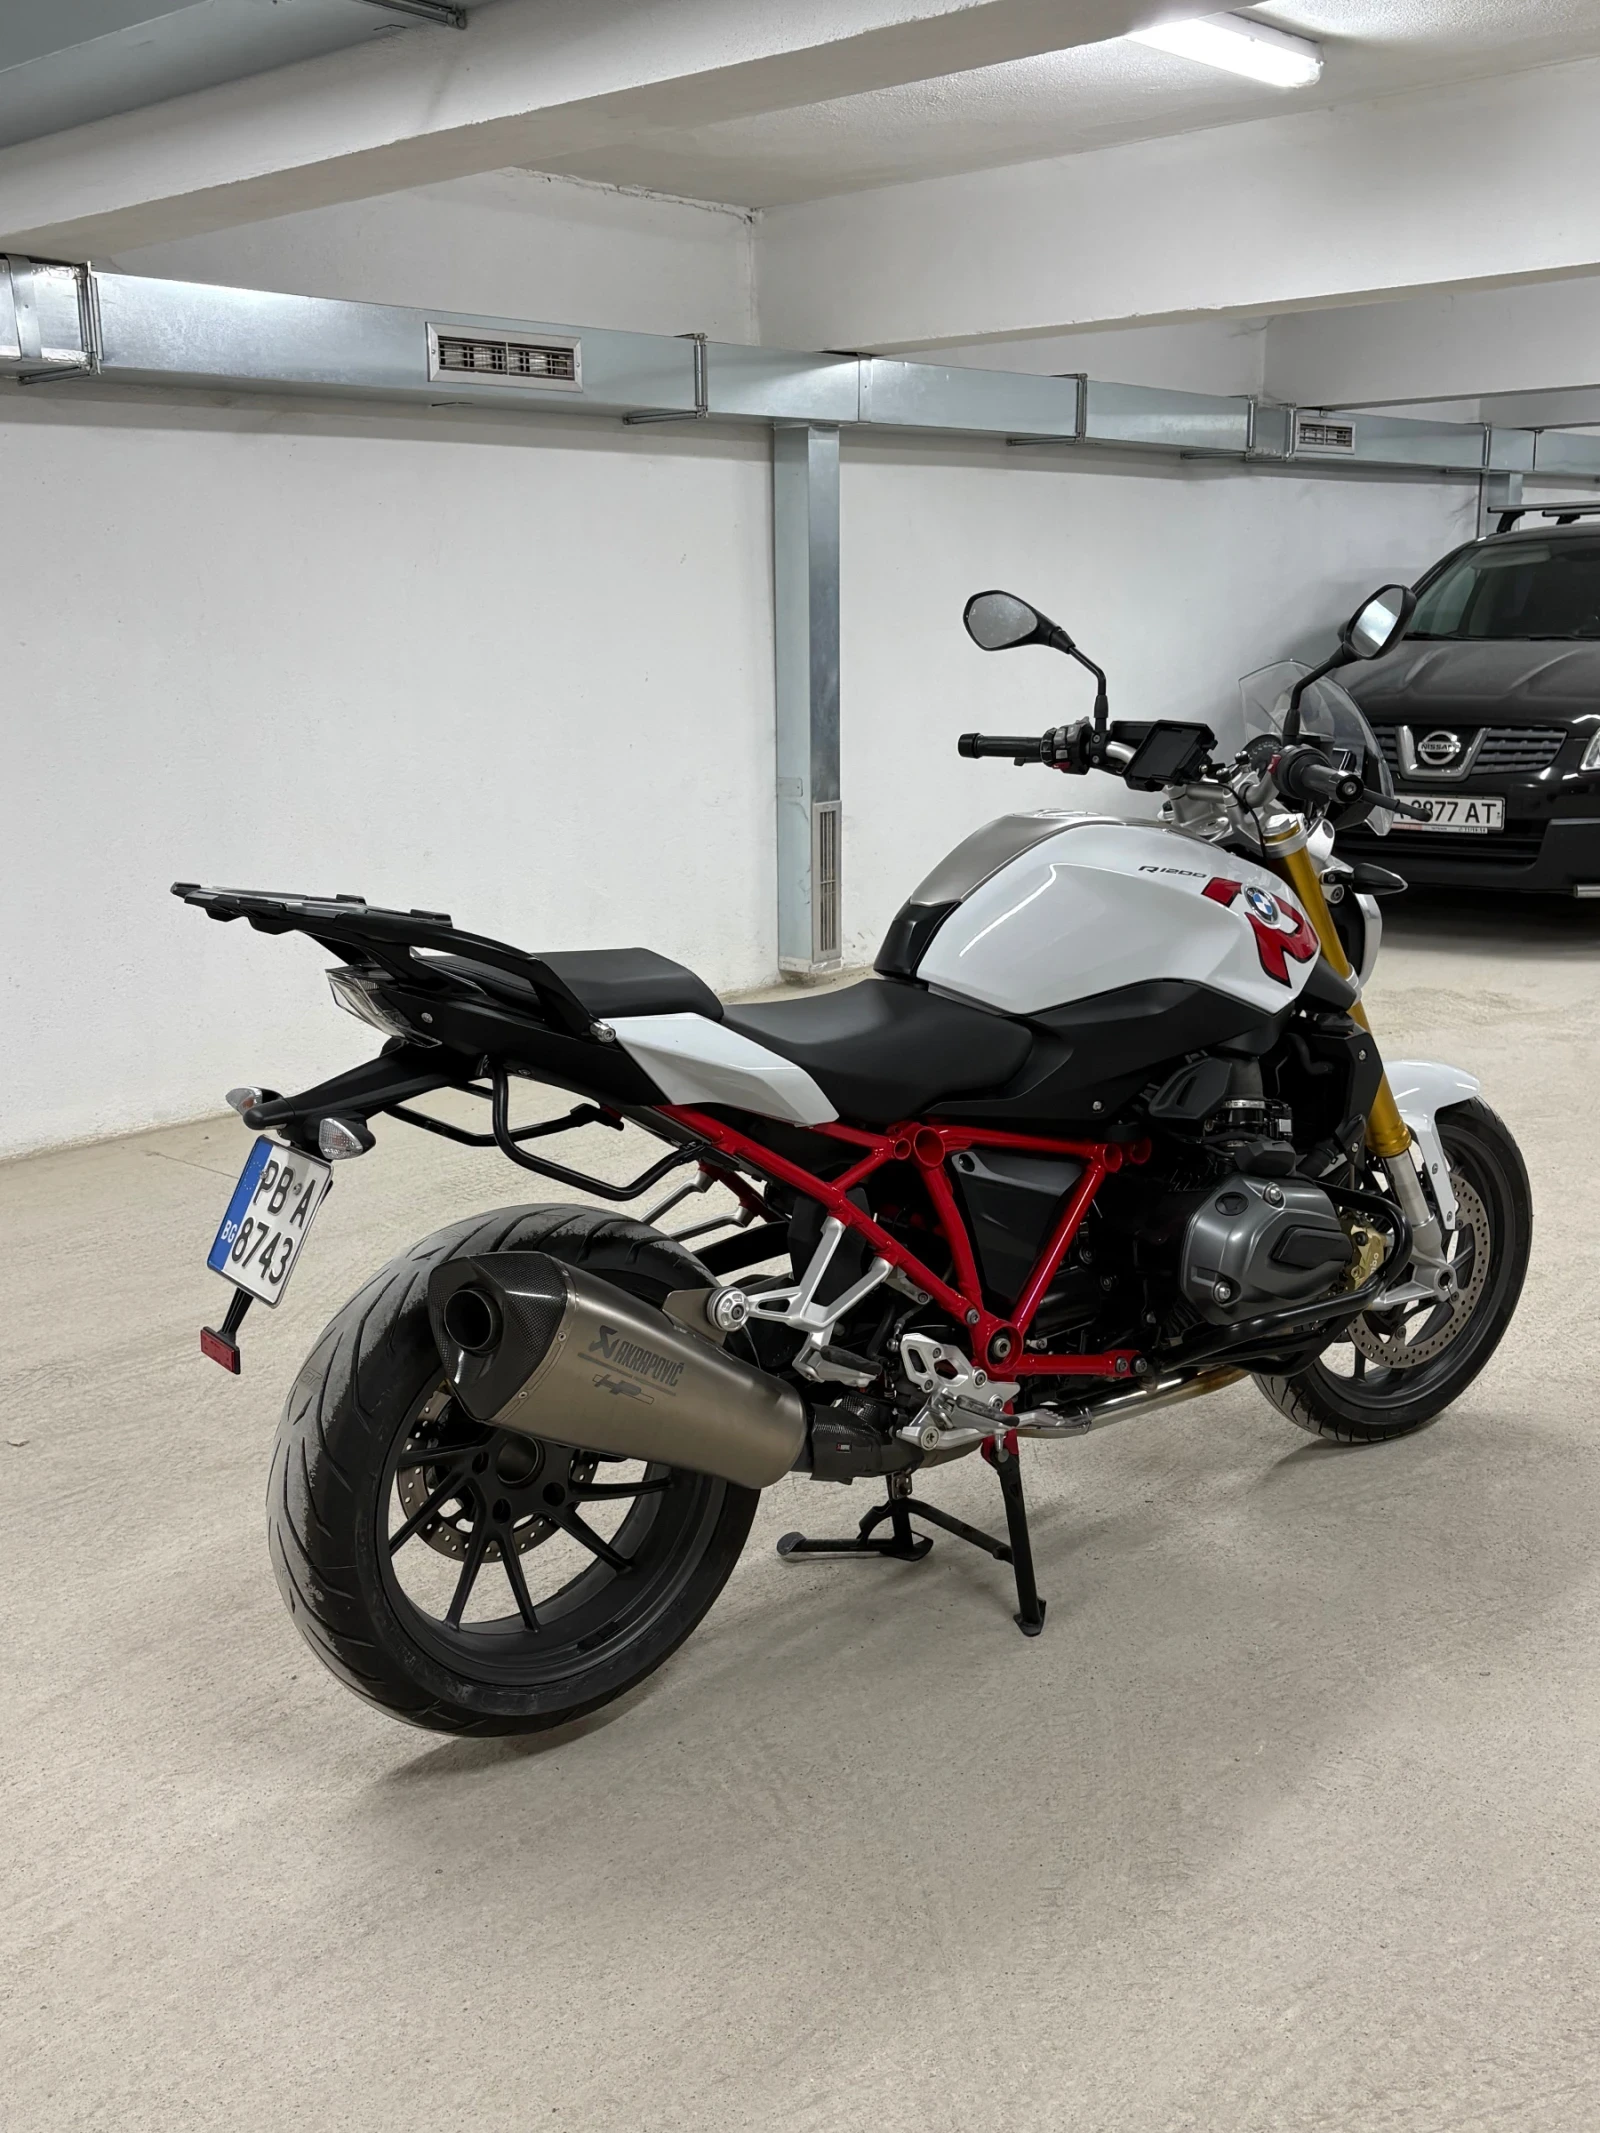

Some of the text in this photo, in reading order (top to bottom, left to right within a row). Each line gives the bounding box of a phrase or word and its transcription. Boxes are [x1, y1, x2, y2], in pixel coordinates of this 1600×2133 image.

[1465, 802, 1497, 824] AT
[254, 1160, 316, 1228] PB A
[221, 1219, 238, 1243] BG
[231, 1217, 294, 1285] 8743
